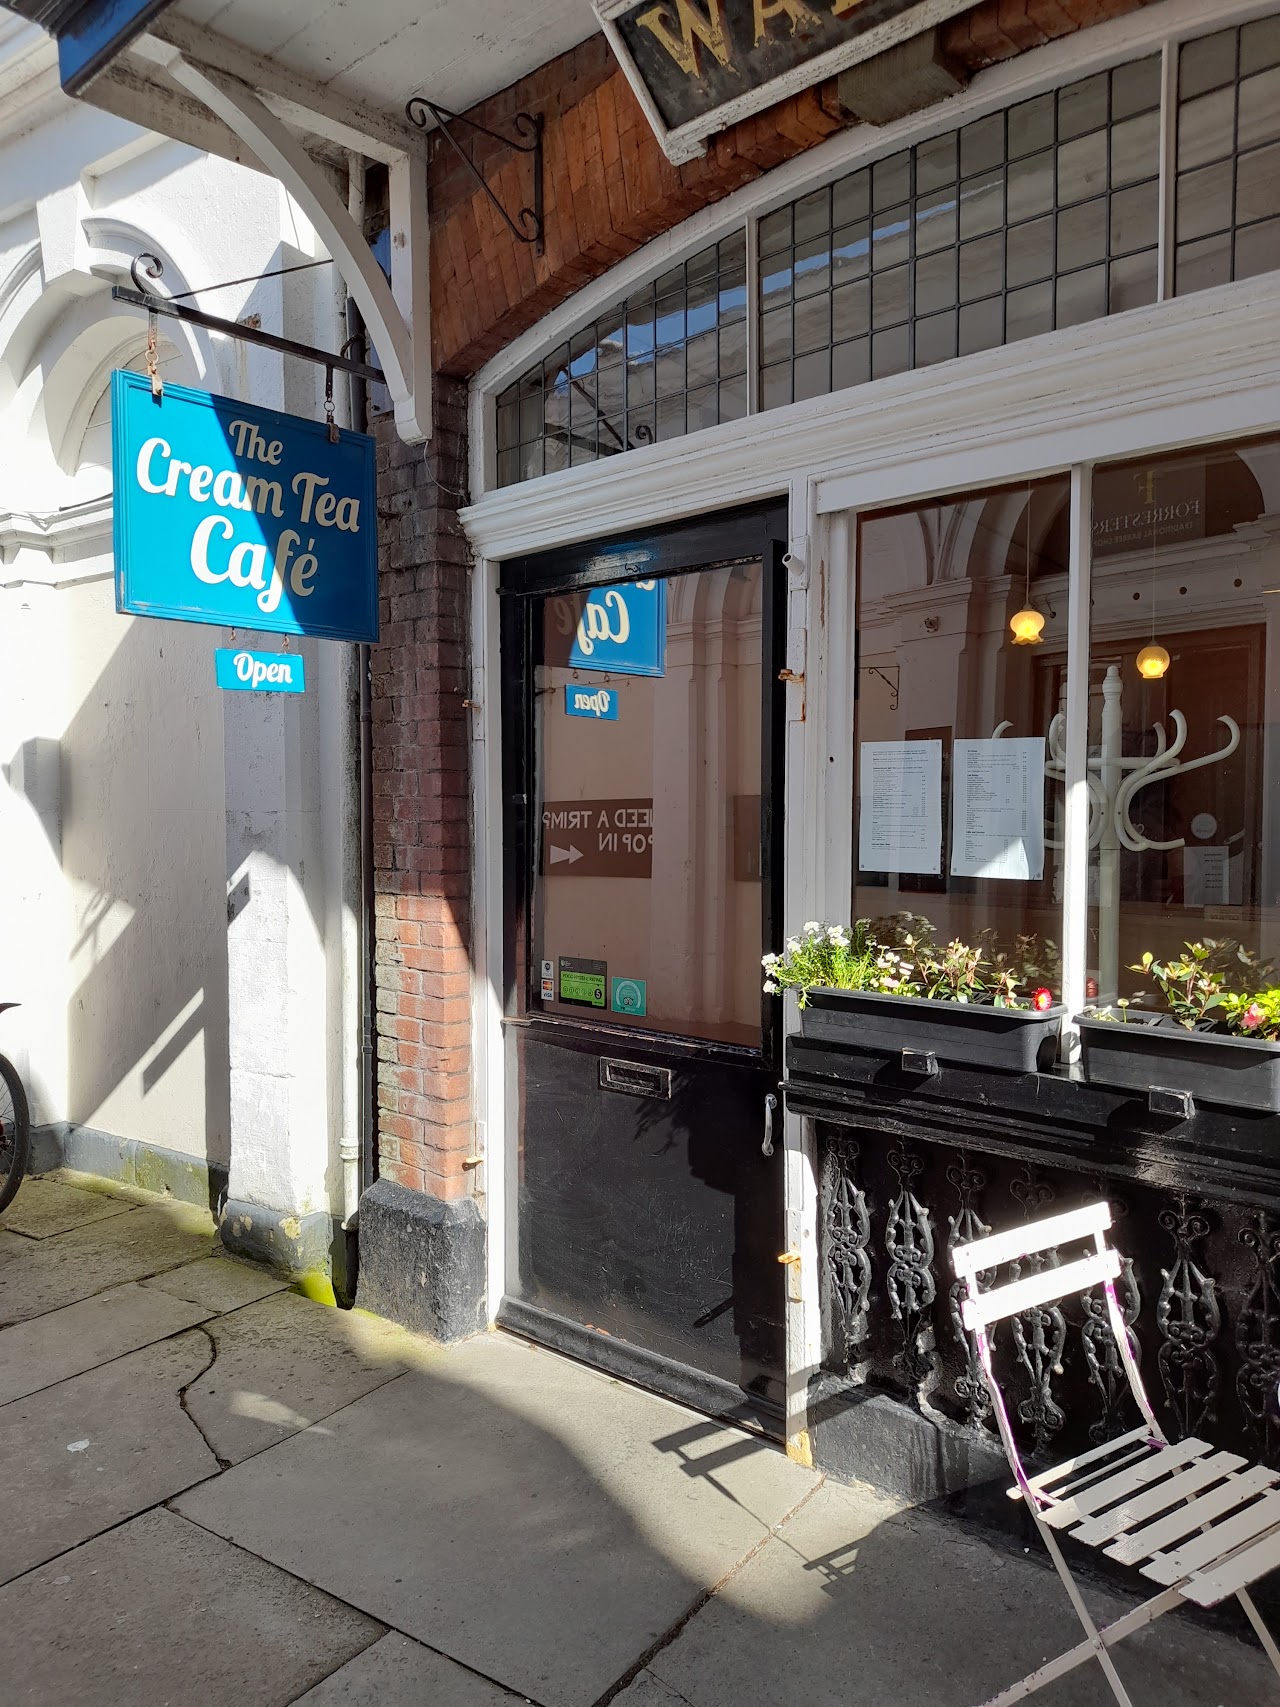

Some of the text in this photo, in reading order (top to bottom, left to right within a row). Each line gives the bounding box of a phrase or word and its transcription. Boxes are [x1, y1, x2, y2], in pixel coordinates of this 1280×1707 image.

[228, 419, 284, 466] The
[136, 437, 360, 533] Cream Tea
[190, 514, 319, 613] Café
[232, 652, 293, 688] Open
[595, 989, 601, 999] 5
